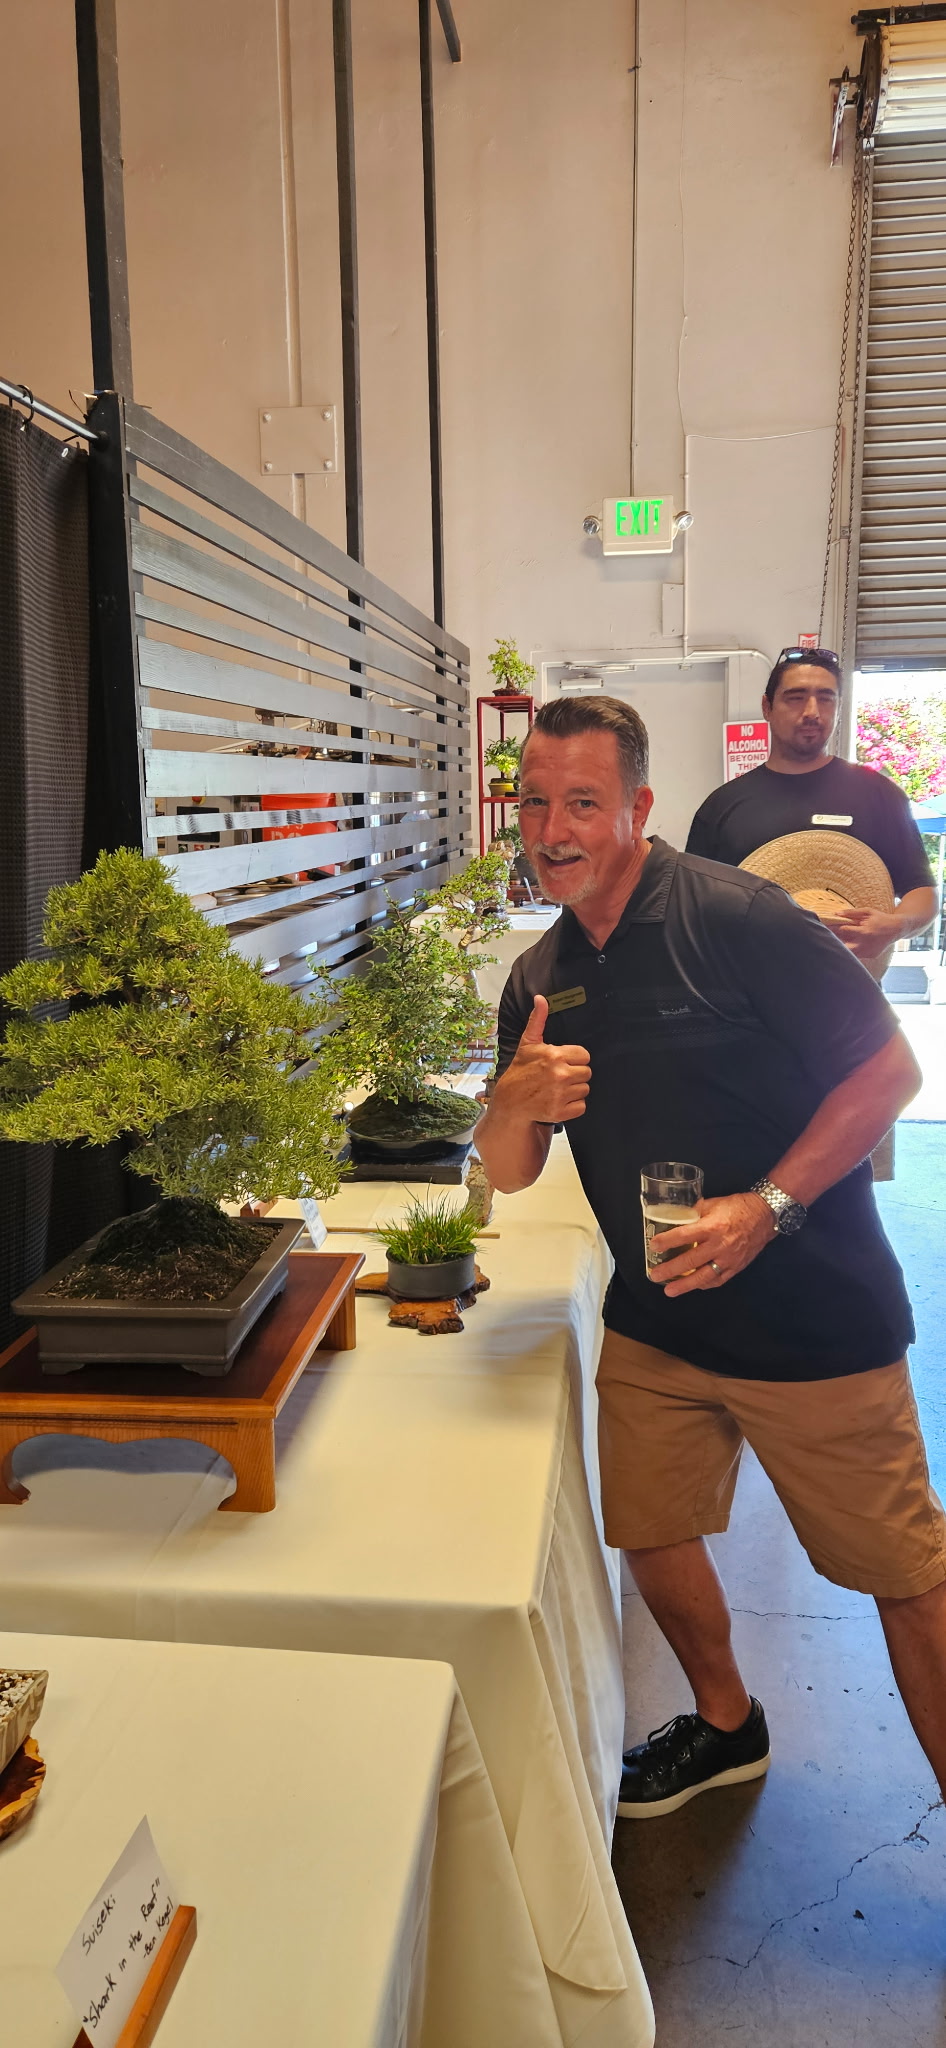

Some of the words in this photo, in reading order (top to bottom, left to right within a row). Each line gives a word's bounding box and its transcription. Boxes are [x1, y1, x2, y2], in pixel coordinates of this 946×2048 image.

[616, 499, 664, 536] EXIT
[801, 639, 816, 649] FIRE
[740, 725, 754, 737] NO
[728, 739, 768, 752] ALCOHOL
[730, 753, 766, 762] BEYOND
[737, 763, 758, 771] THIS
[118, 1958, 127, 1972] in
[128, 1930, 143, 1951] the
